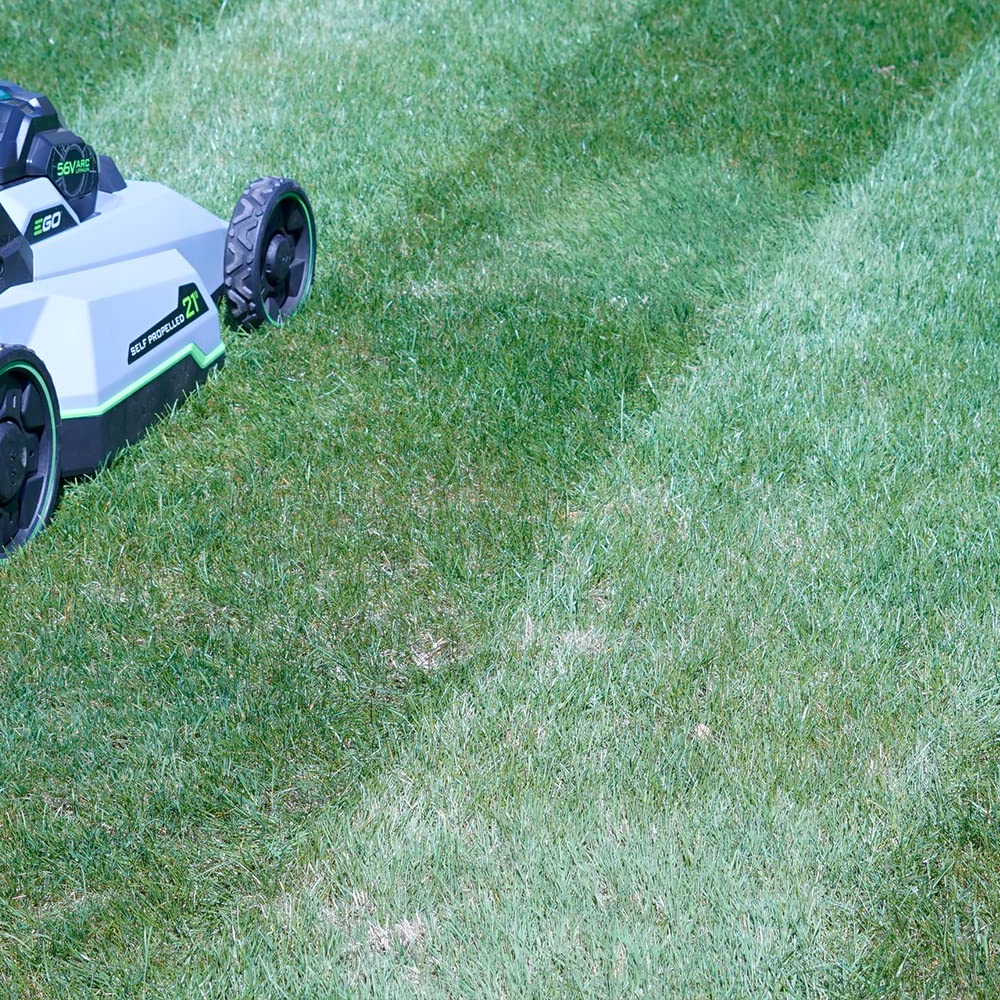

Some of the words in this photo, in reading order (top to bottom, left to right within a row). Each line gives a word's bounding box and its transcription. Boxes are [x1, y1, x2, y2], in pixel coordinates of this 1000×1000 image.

[57, 160, 77, 176] 56V
[33, 211, 62, 236] EGO
[130, 338, 148, 356] SELF
[147, 314, 185, 345] PROPELLED
